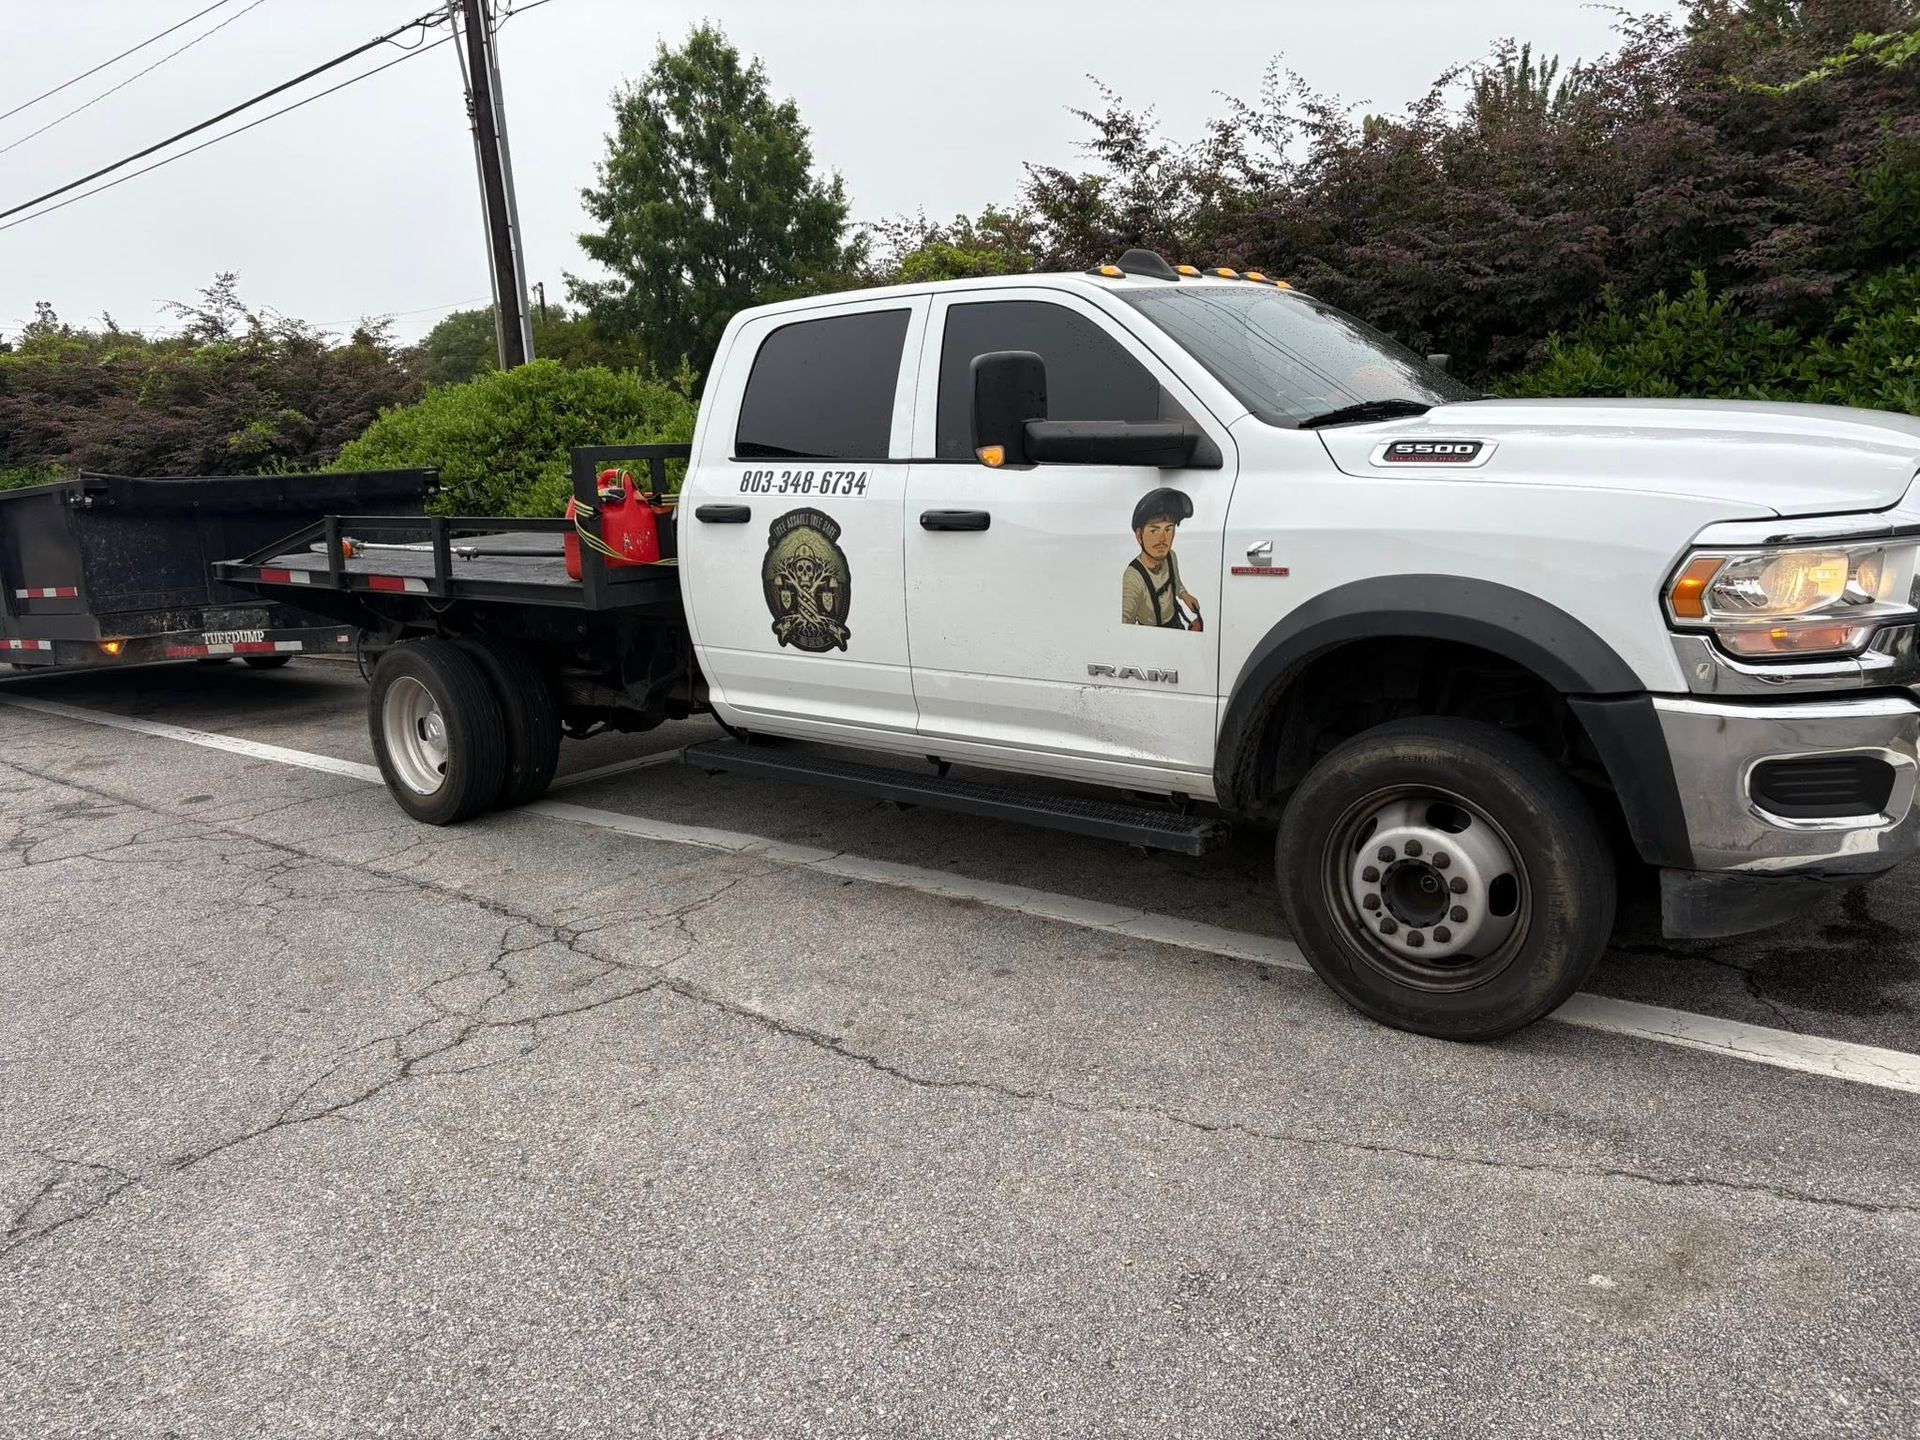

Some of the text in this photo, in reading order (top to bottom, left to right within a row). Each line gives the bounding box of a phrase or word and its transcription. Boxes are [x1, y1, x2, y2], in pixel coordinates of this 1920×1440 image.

[1395, 444, 1474, 454] 5500
[739, 470, 868, 496] 803-348-6734
[786, 513, 809, 529] ASSAULT
[201, 630, 265, 645] TUFFDUMP
[1087, 662, 1178, 684] RAM
